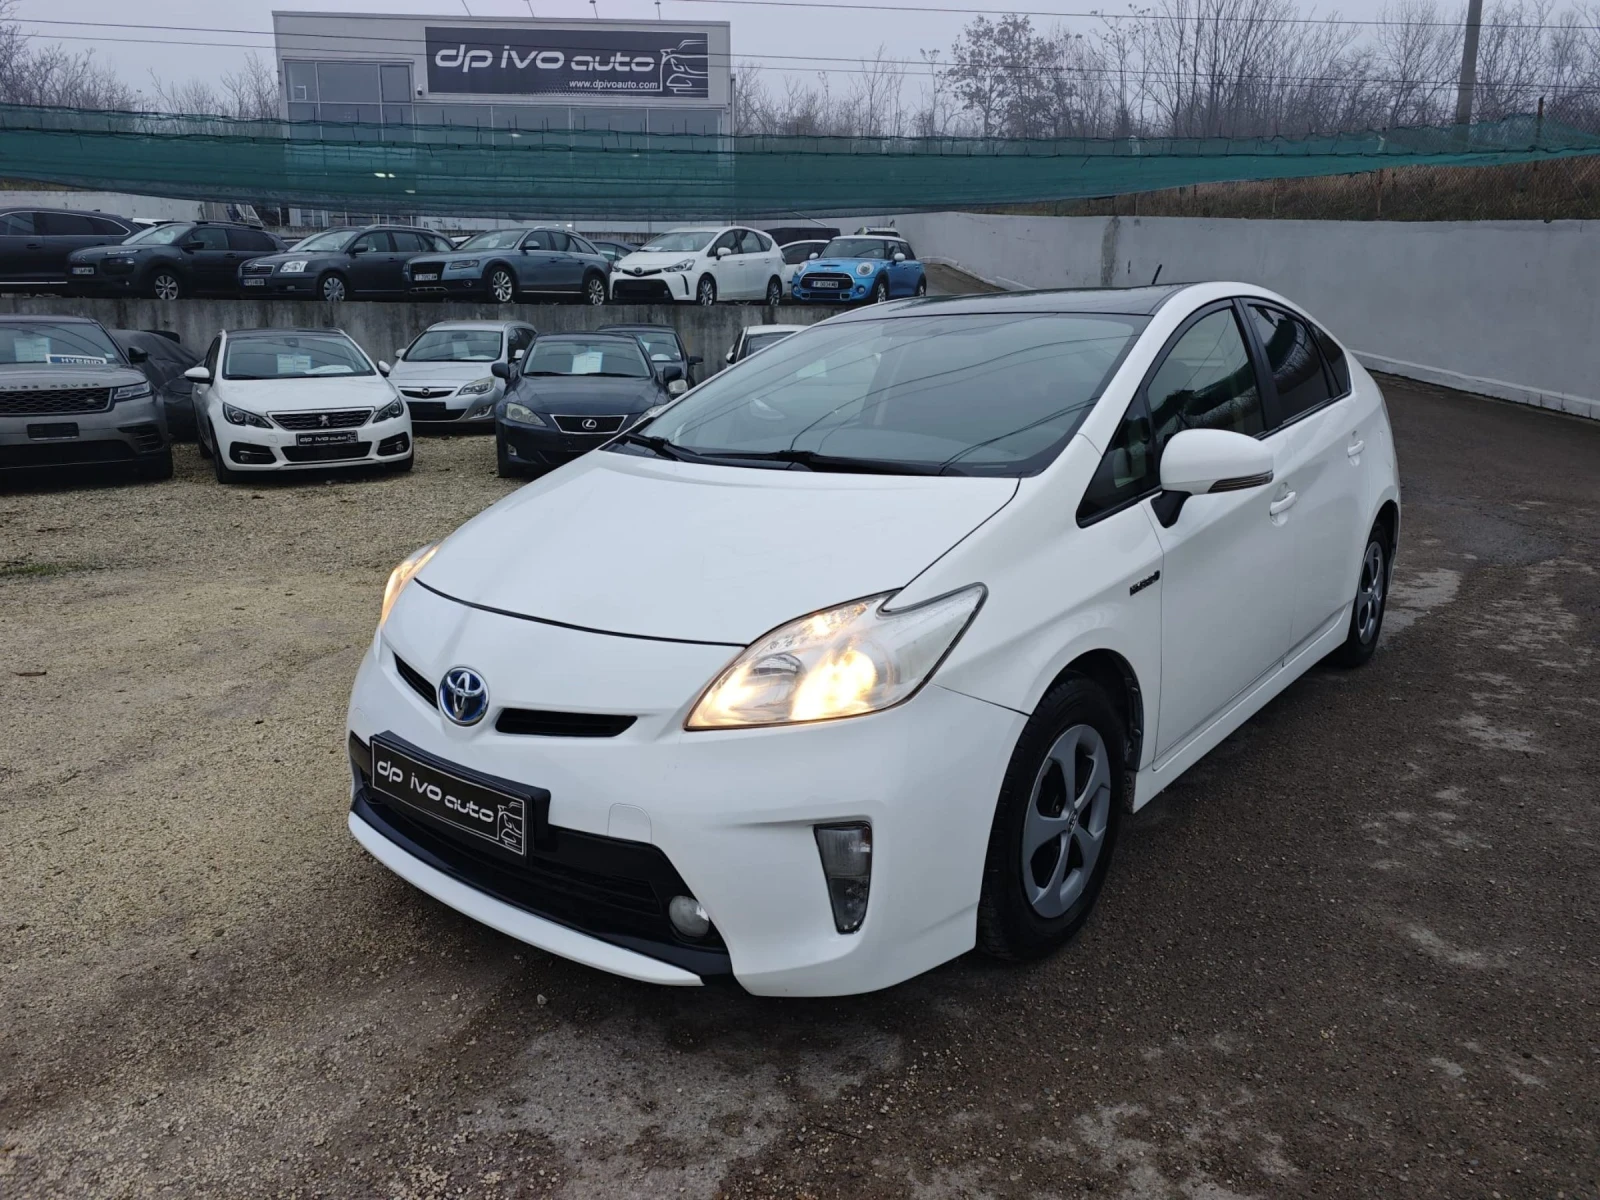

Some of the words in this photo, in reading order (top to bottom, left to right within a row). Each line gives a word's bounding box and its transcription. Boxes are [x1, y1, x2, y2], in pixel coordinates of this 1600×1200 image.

[435, 44, 493, 73] dp
[500, 45, 565, 69] ivo
[570, 52, 655, 72] auto
[569, 79, 658, 90] www.dpivoauto.com
[377, 761, 403, 784] dp
[410, 772, 442, 801] ivo
[444, 795, 494, 823] auto
